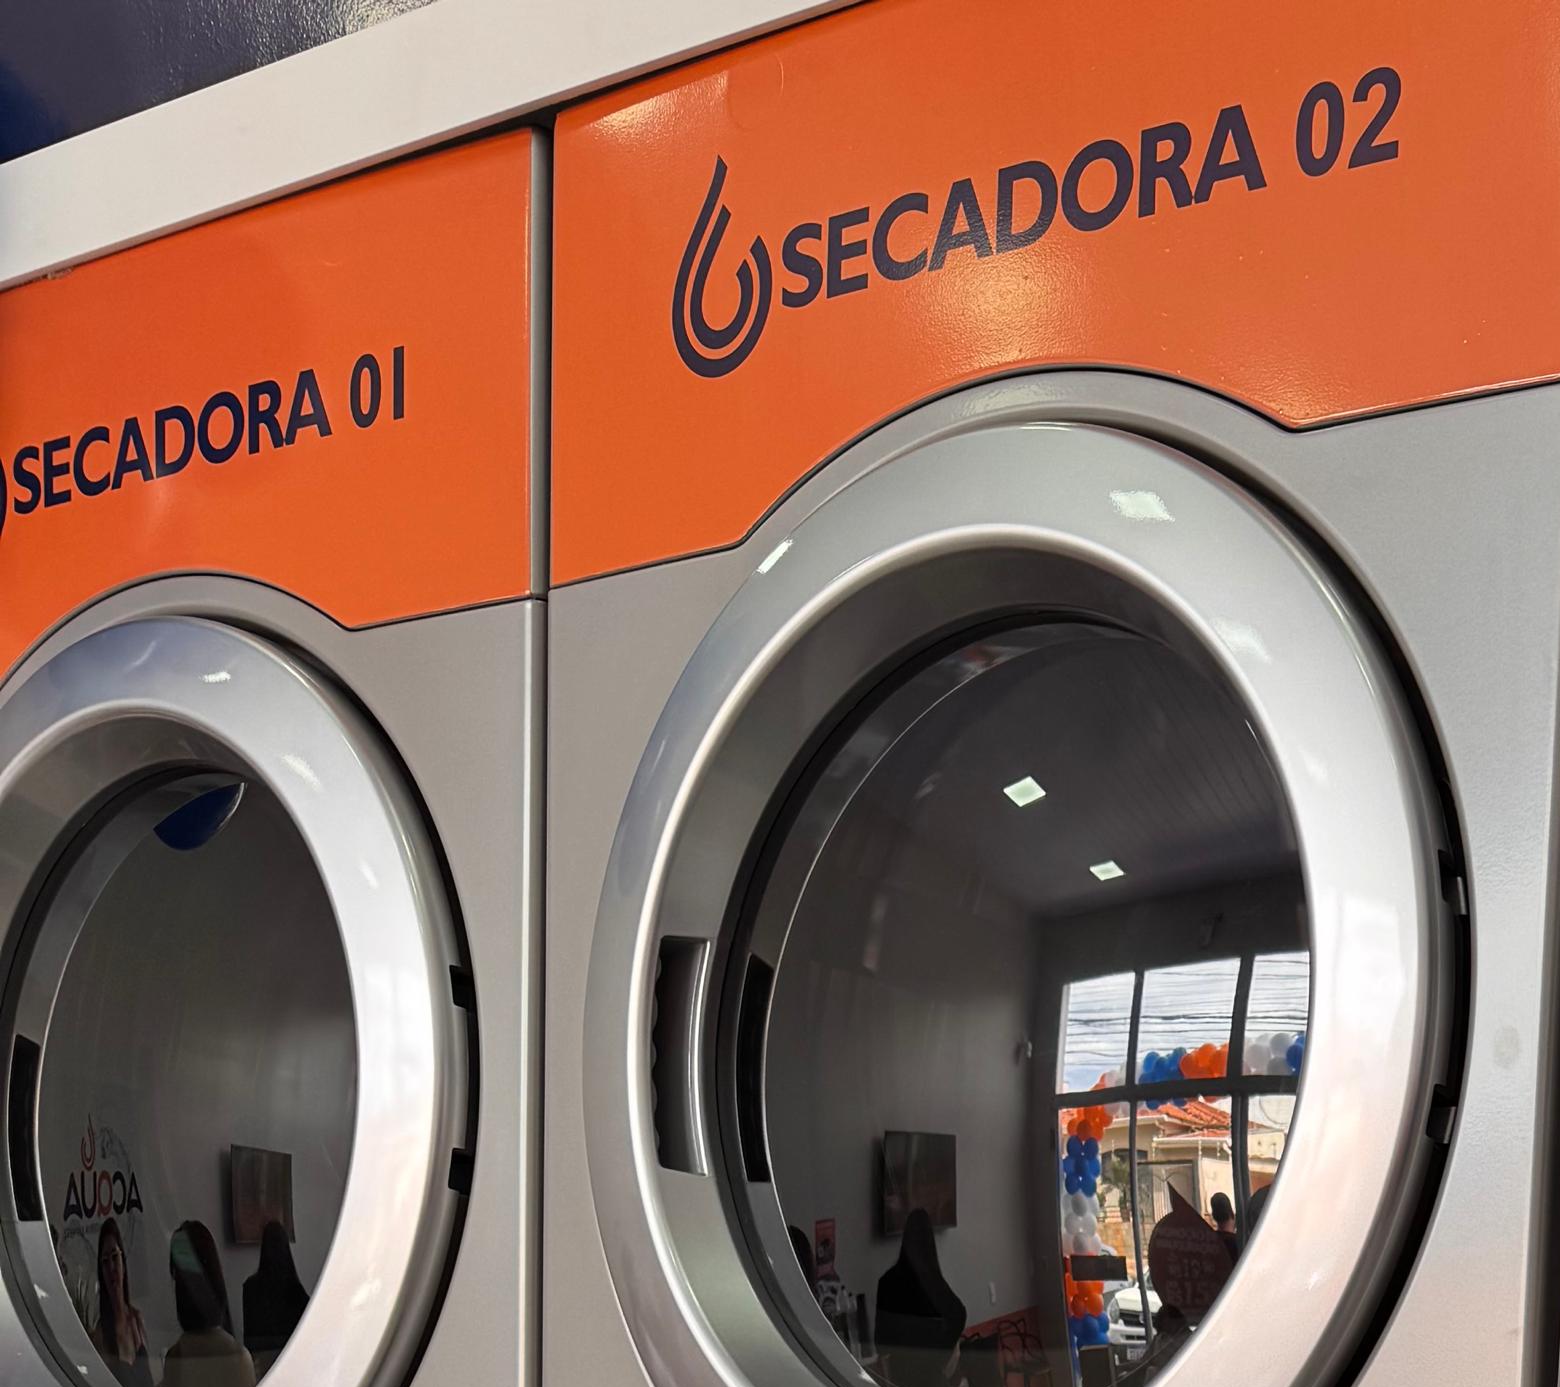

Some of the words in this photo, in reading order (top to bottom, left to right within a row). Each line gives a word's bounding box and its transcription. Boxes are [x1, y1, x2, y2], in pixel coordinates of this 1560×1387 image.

[782, 104, 1267, 308] SECADORA
[1295, 67, 1401, 178] 02
[13, 369, 332, 515] SECADORA
[350, 346, 405, 429] 01
